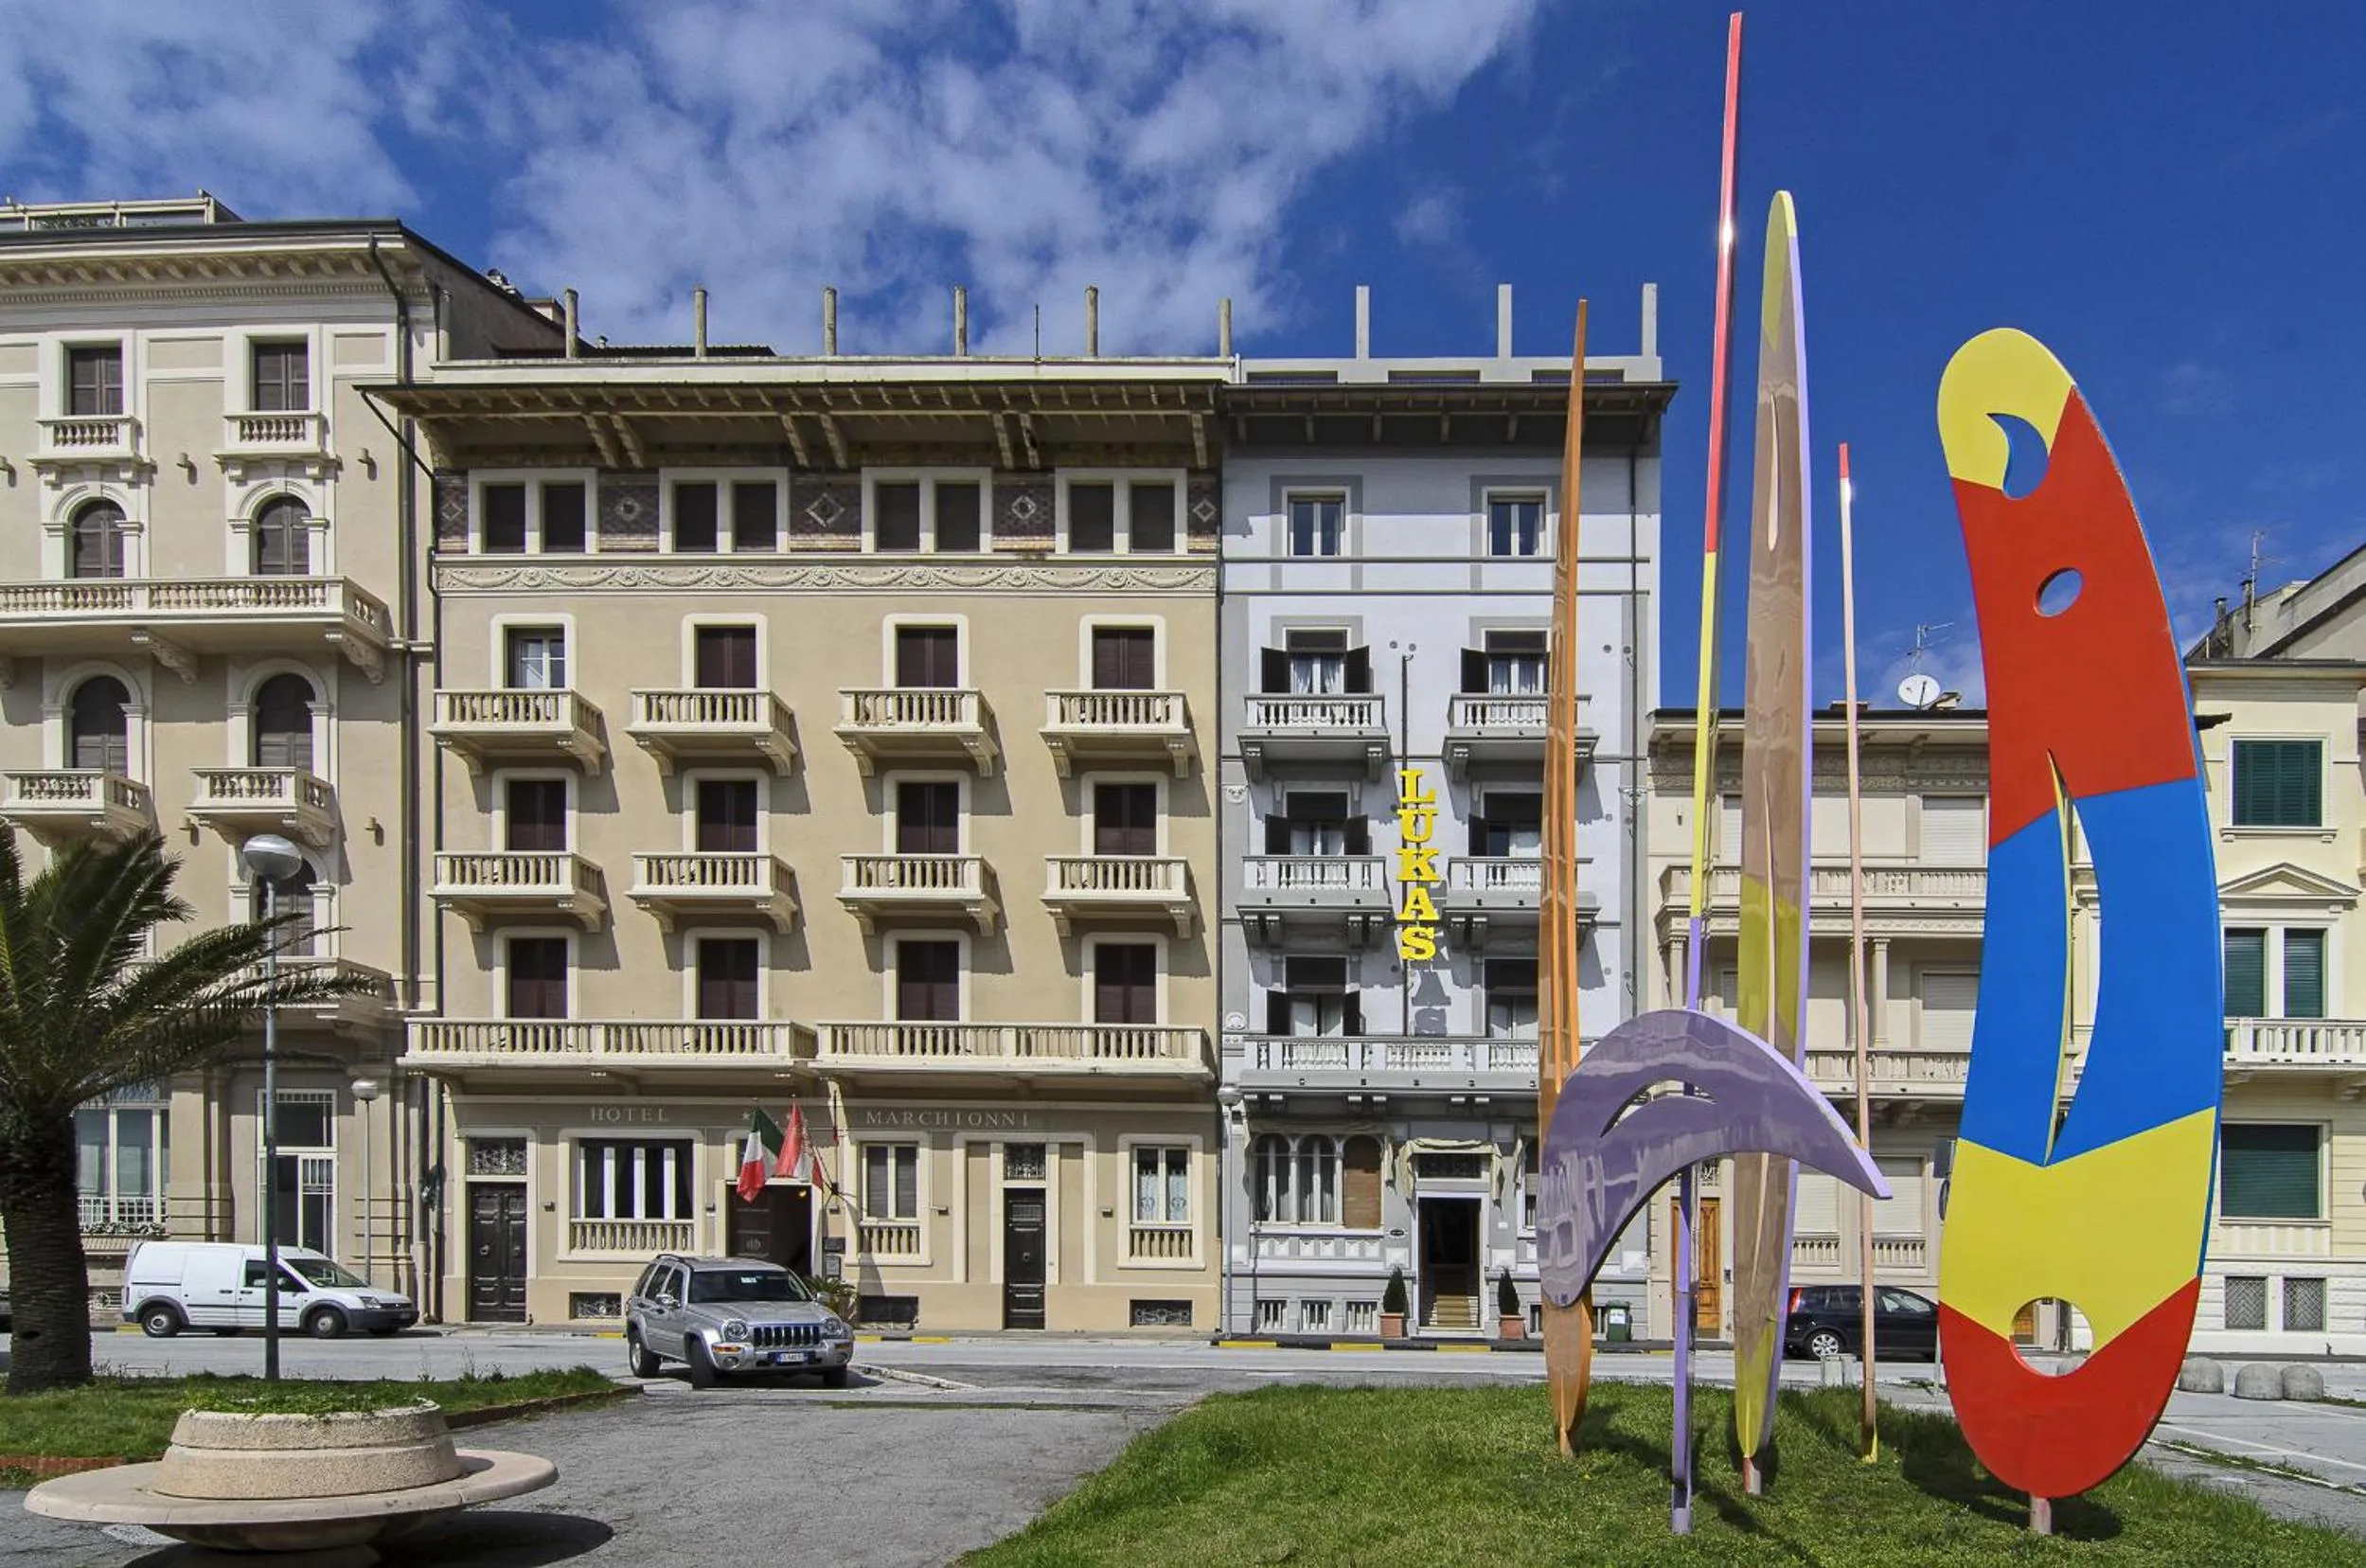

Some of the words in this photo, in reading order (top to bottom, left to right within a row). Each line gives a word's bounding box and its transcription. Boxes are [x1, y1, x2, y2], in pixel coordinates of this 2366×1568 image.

[1396, 769, 1440, 961] LUKAS
[590, 1106, 669, 1122] HOTEL
[865, 1110, 1029, 1128] MARCHIONNI
